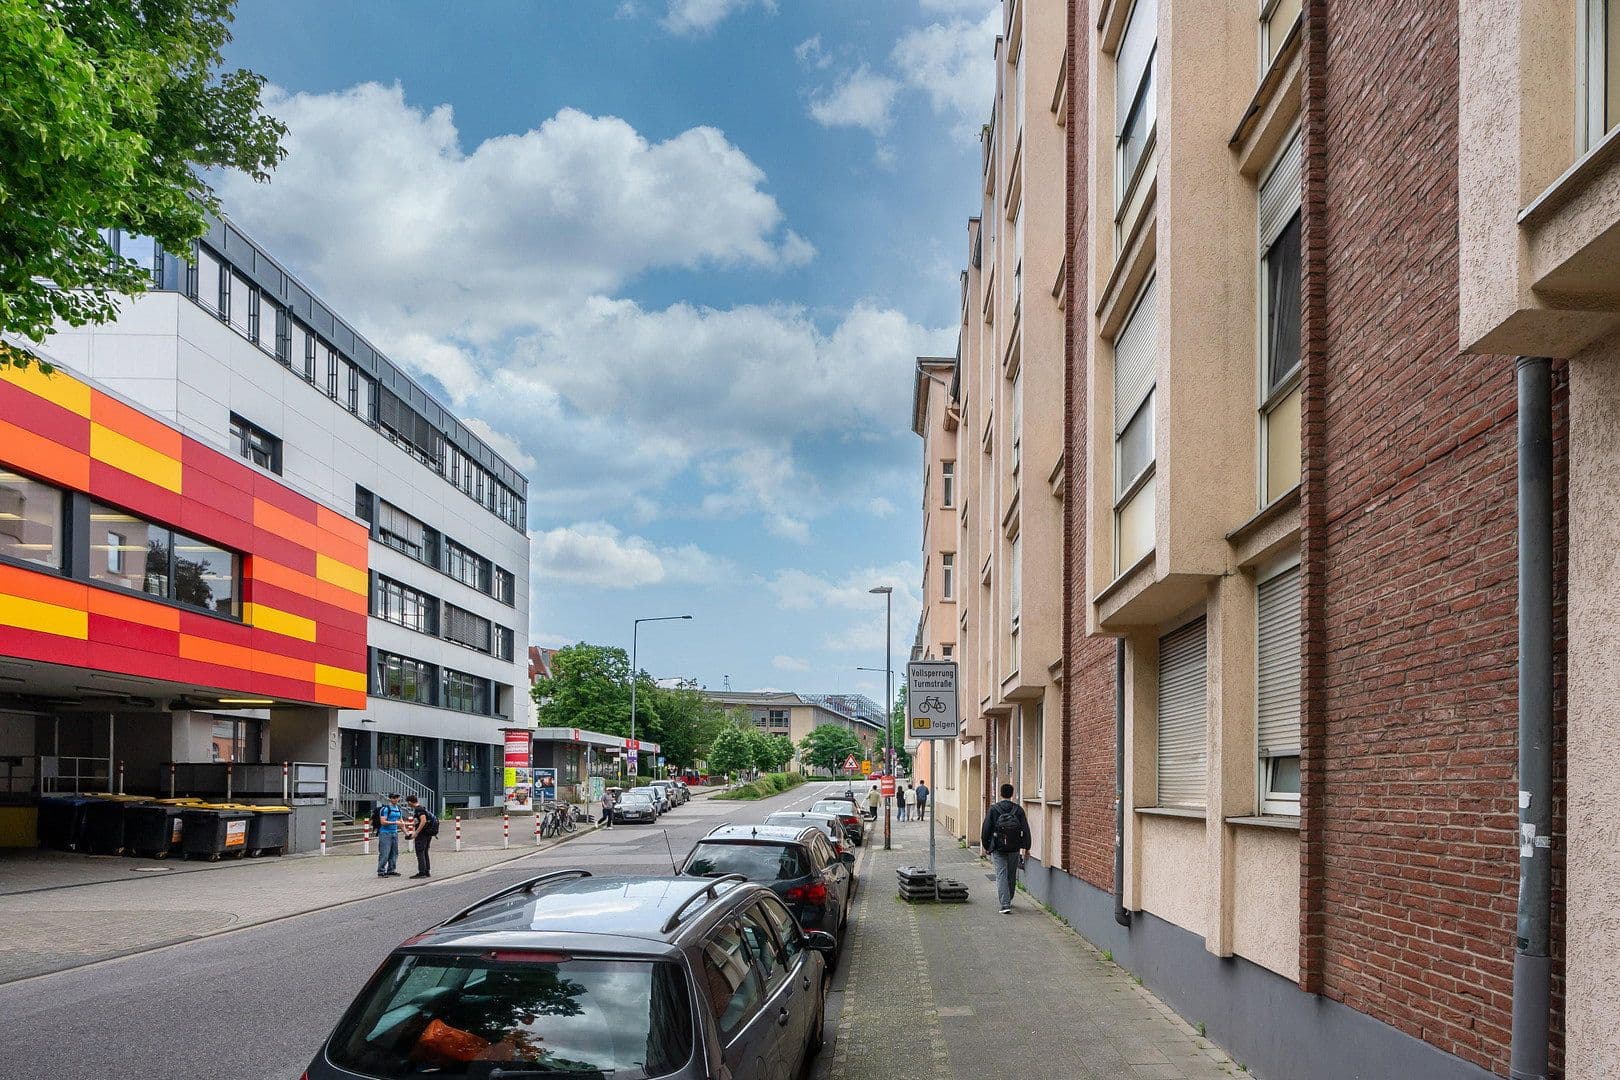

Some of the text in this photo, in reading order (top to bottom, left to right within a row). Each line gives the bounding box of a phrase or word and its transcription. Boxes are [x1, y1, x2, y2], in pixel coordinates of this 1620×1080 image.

[911, 668, 954, 679] Vollsperrung
[913, 679, 952, 688] Turmstraße
[932, 720, 955, 729] folgen
